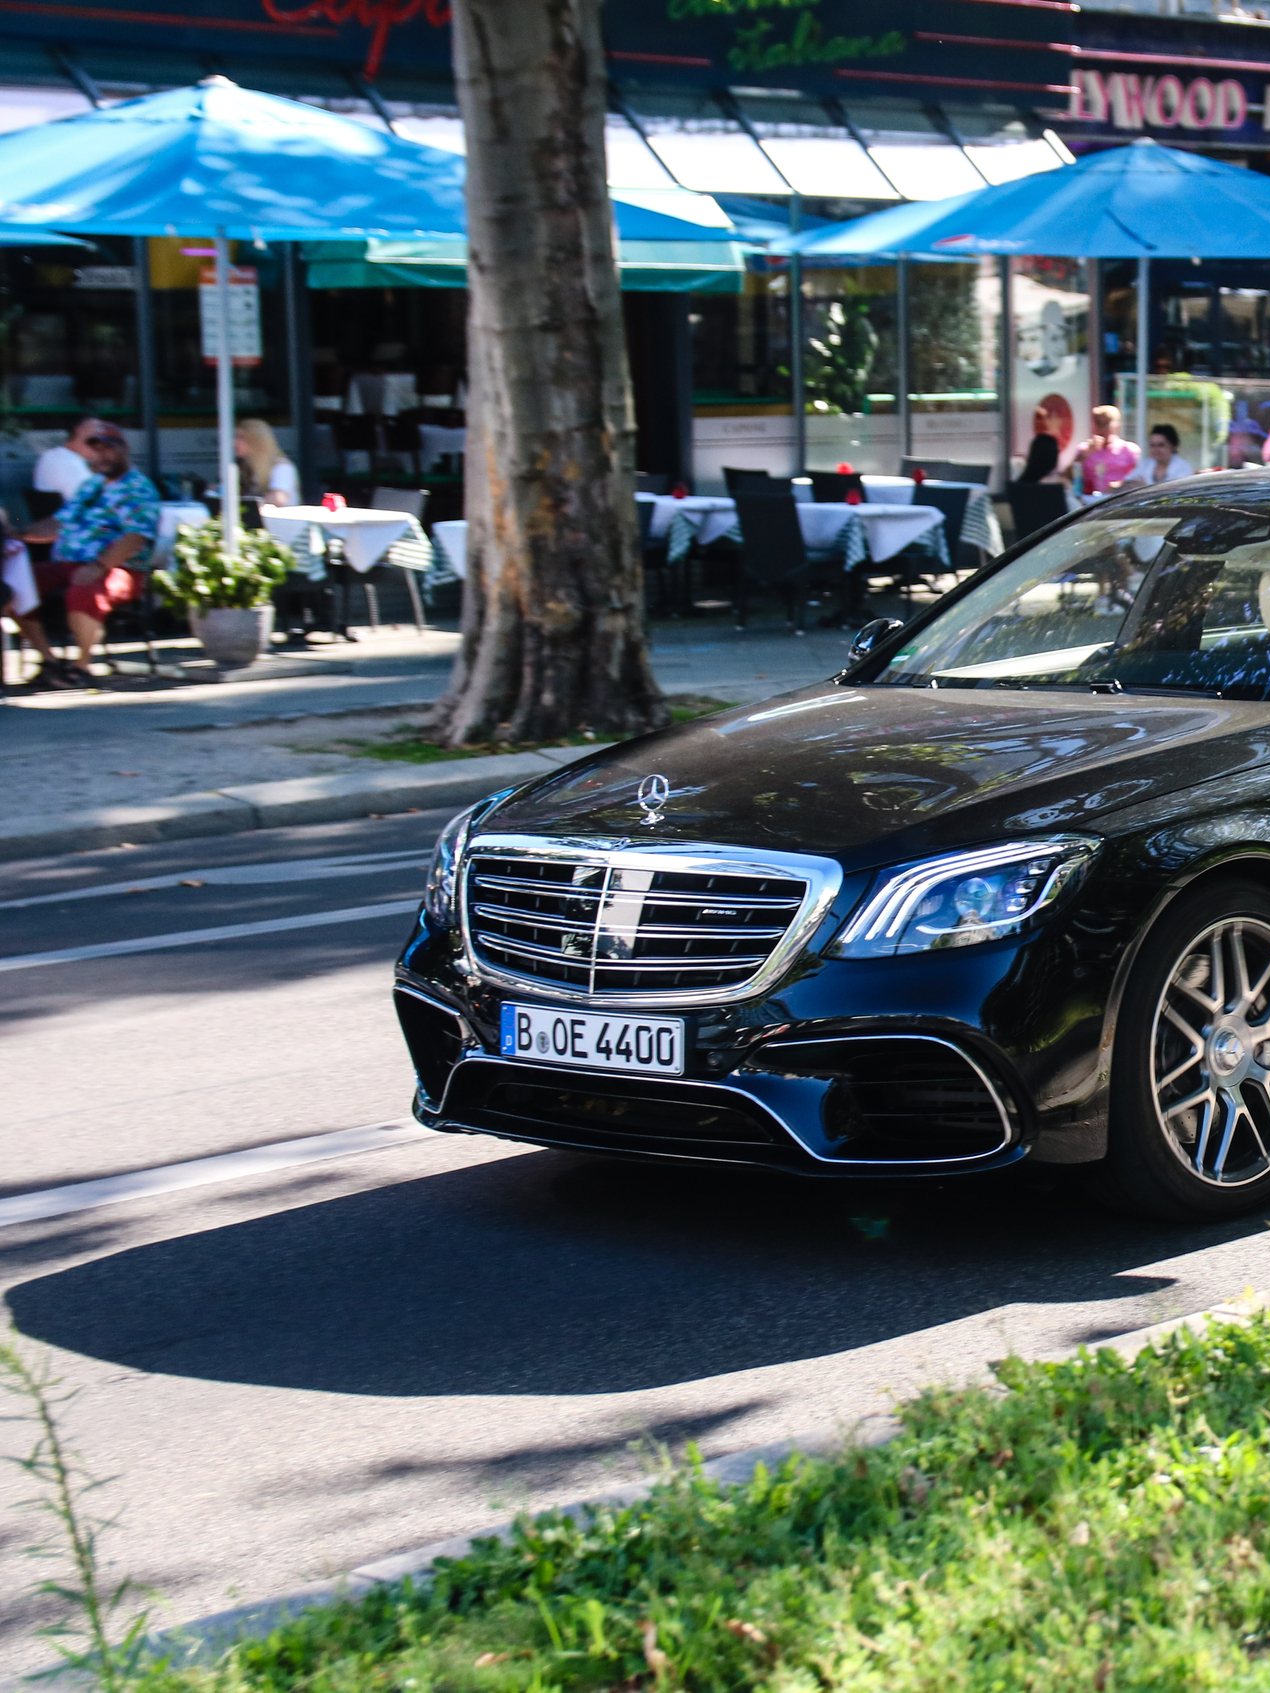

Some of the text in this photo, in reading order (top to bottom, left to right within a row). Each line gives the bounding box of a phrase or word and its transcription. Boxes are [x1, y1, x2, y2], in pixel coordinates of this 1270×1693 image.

[517, 1012, 533, 1051] B
[552, 1017, 588, 1058] OE
[596, 1022, 674, 1066] 4400
